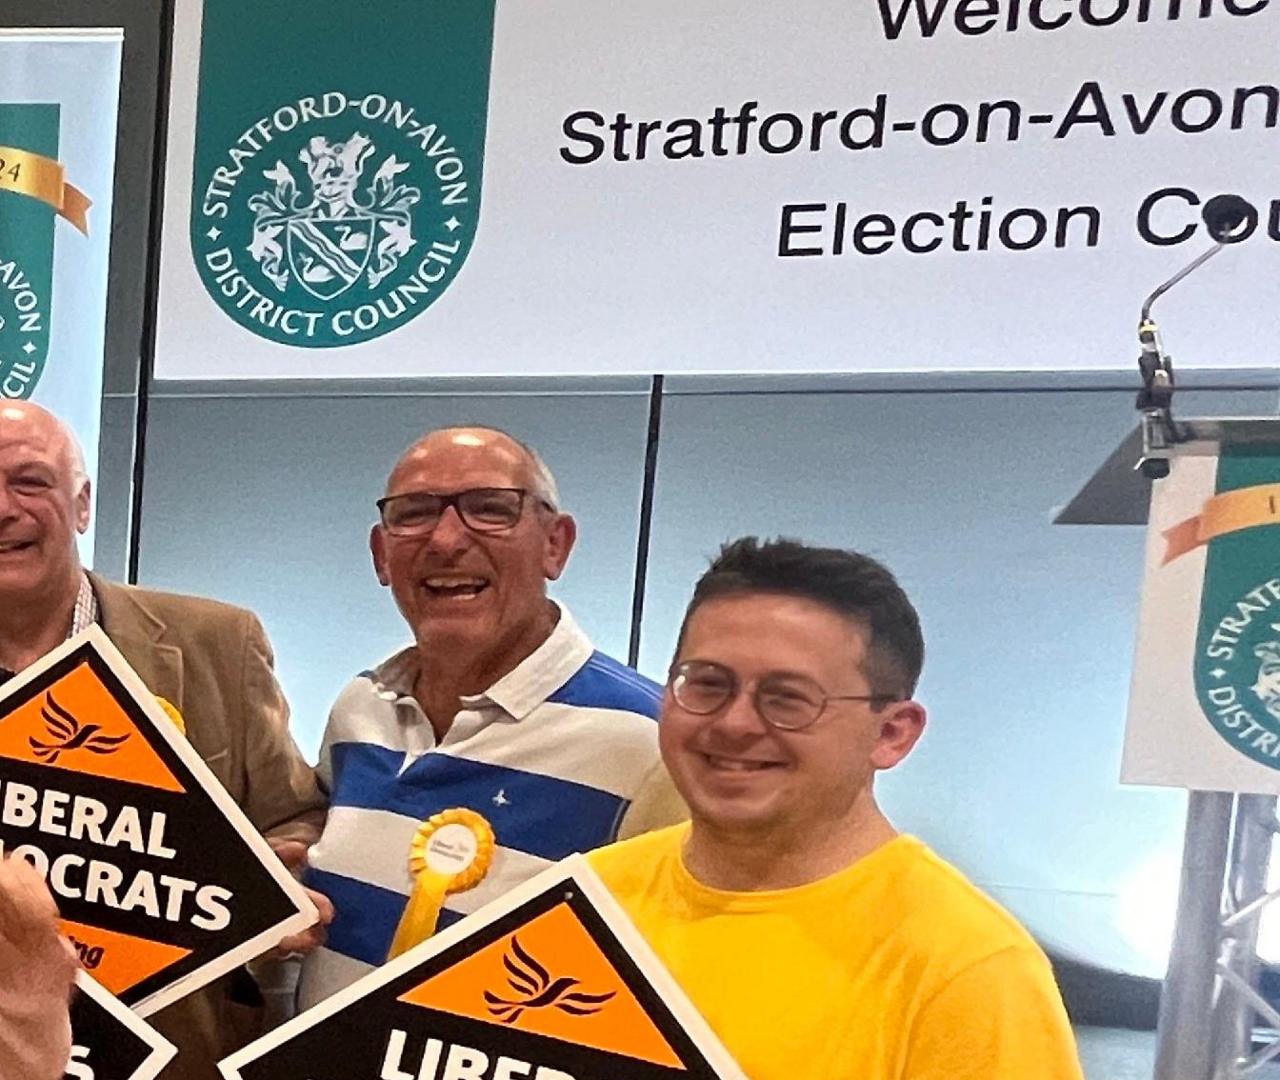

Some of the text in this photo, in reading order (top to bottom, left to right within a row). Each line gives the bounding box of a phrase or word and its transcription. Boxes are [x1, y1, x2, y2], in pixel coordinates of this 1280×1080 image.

[203, 92, 468, 219] STRATFORD-ON-AVON
[559, 81, 1280, 164] Stratford-on-Avon
[778, 196, 1102, 257] Election
[206, 239, 461, 337] DISTRICT COUNCIL
